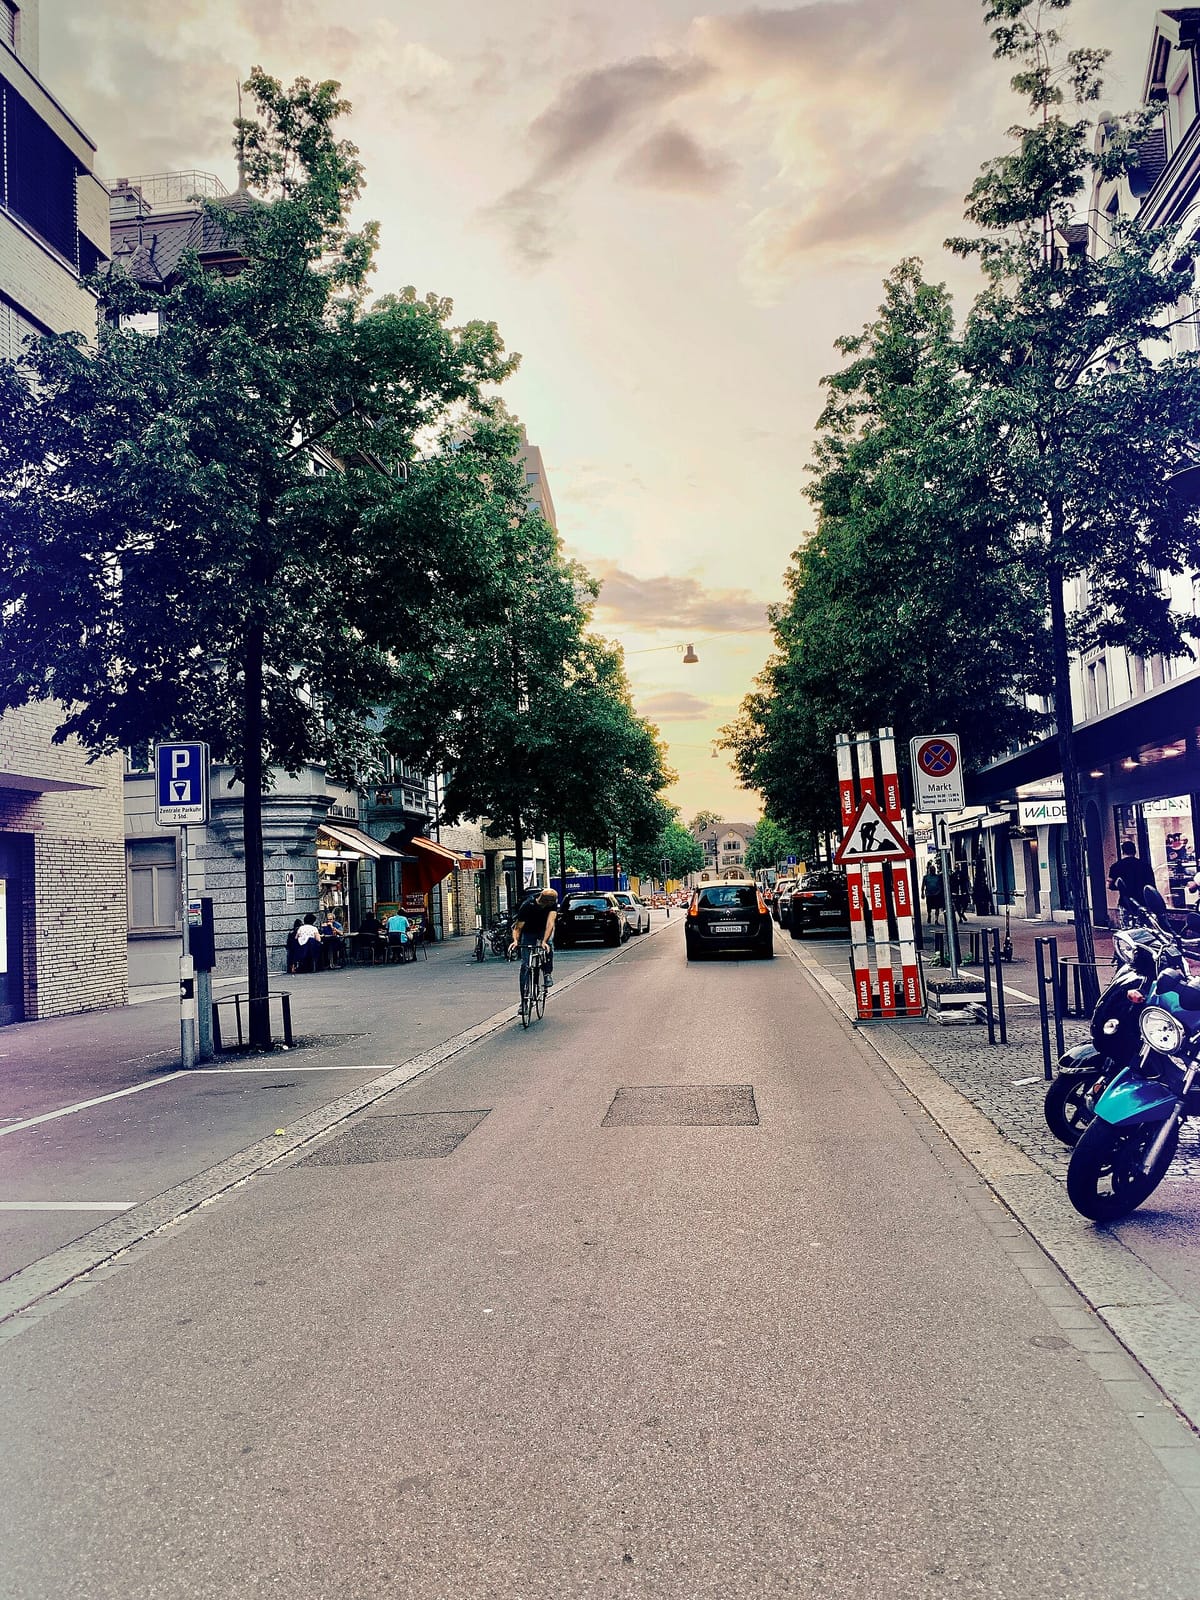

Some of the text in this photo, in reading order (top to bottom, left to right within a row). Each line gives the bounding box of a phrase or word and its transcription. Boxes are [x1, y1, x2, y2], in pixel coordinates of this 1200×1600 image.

[172, 750, 190, 778] P
[888, 786, 896, 809] KIBAG
[928, 782, 952, 792] Markt
[898, 880, 906, 905] KIBAG
[860, 981, 868, 1006] KIBAG
[882, 982, 890, 1006] KIBAG
